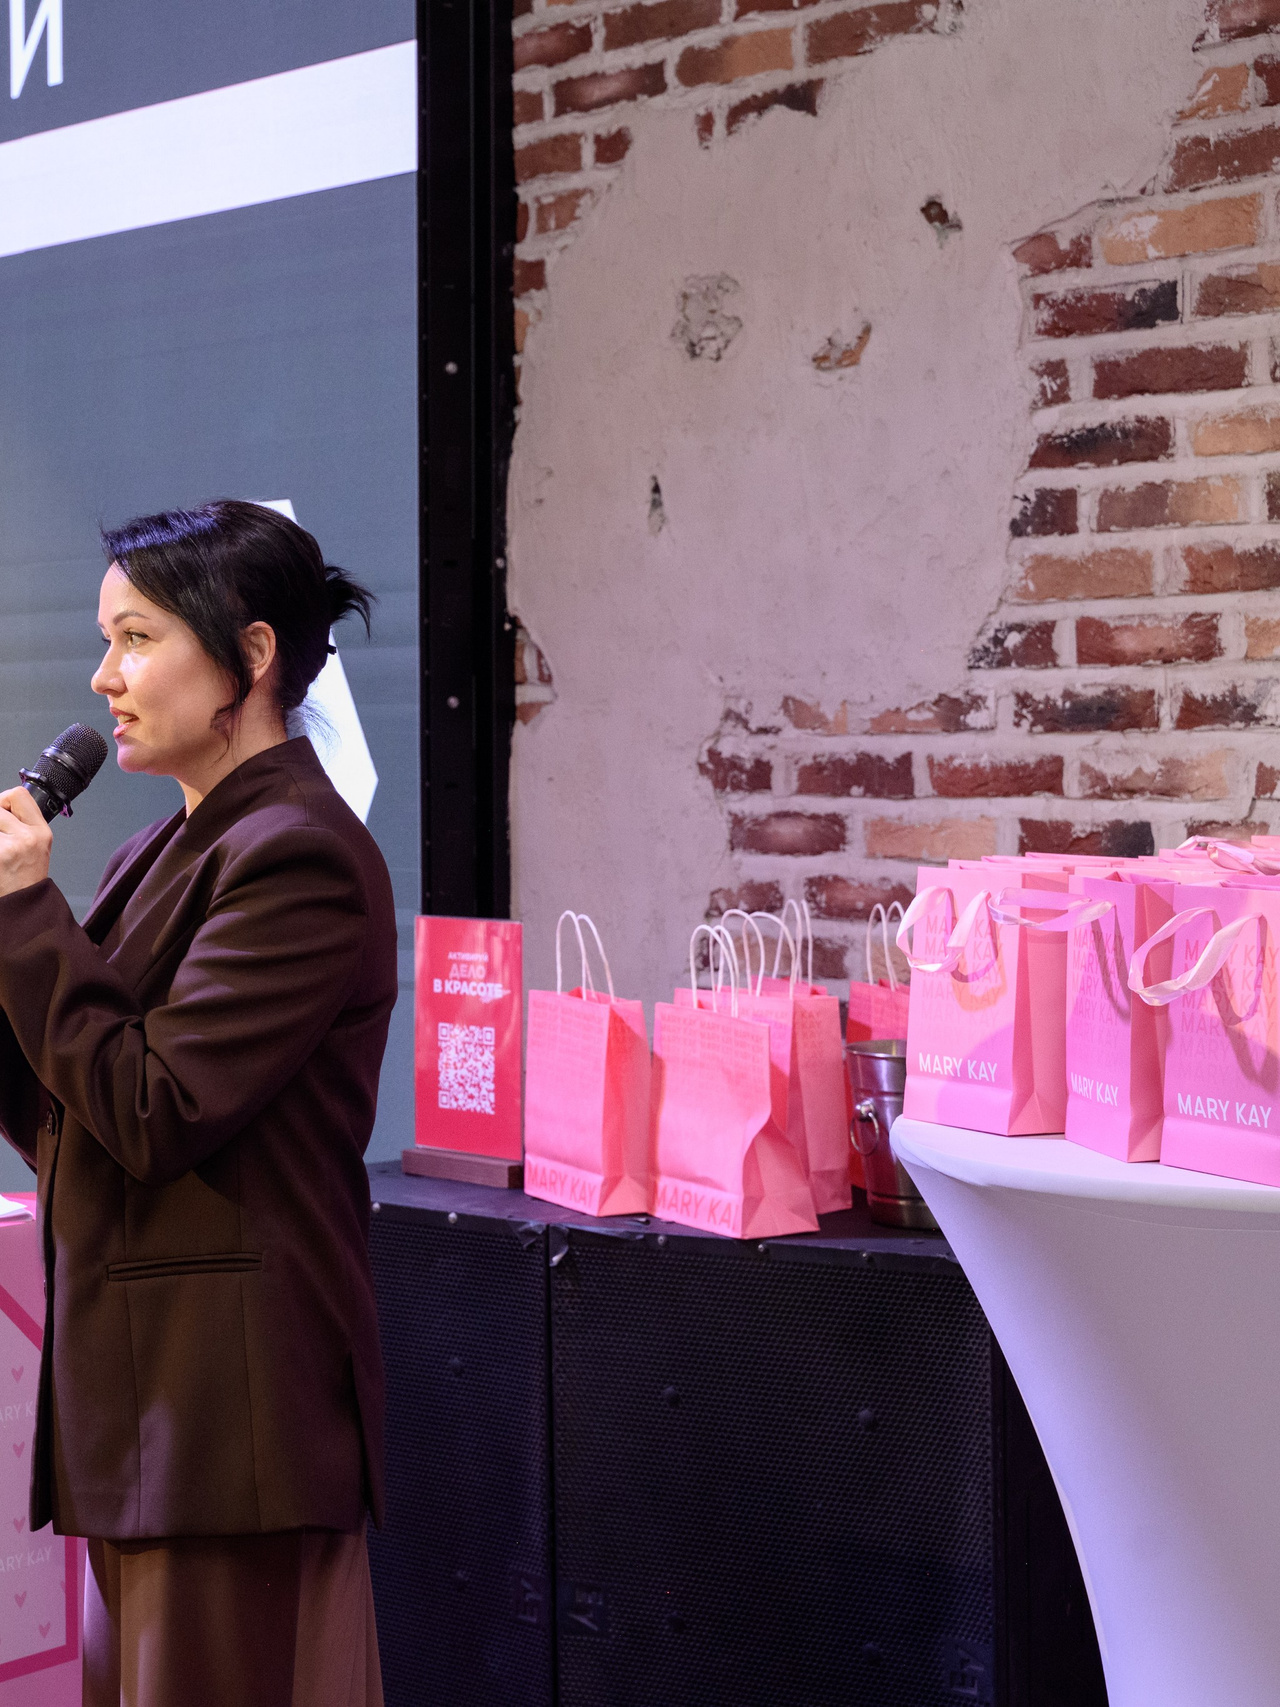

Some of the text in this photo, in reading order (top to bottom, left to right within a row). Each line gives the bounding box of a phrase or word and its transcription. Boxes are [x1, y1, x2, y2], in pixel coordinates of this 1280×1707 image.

[449, 963, 486, 980] ДЕЛО
[433, 978, 503, 998] В КРАСОТЕ
[919, 1052, 998, 1083] MARY KAY
[1071, 1072, 1119, 1107] MARY KAY
[1177, 1093, 1271, 1129] MARY KAY
[527, 1162, 597, 1207] MARY KAY
[26, 1546, 53, 1566] KAY
